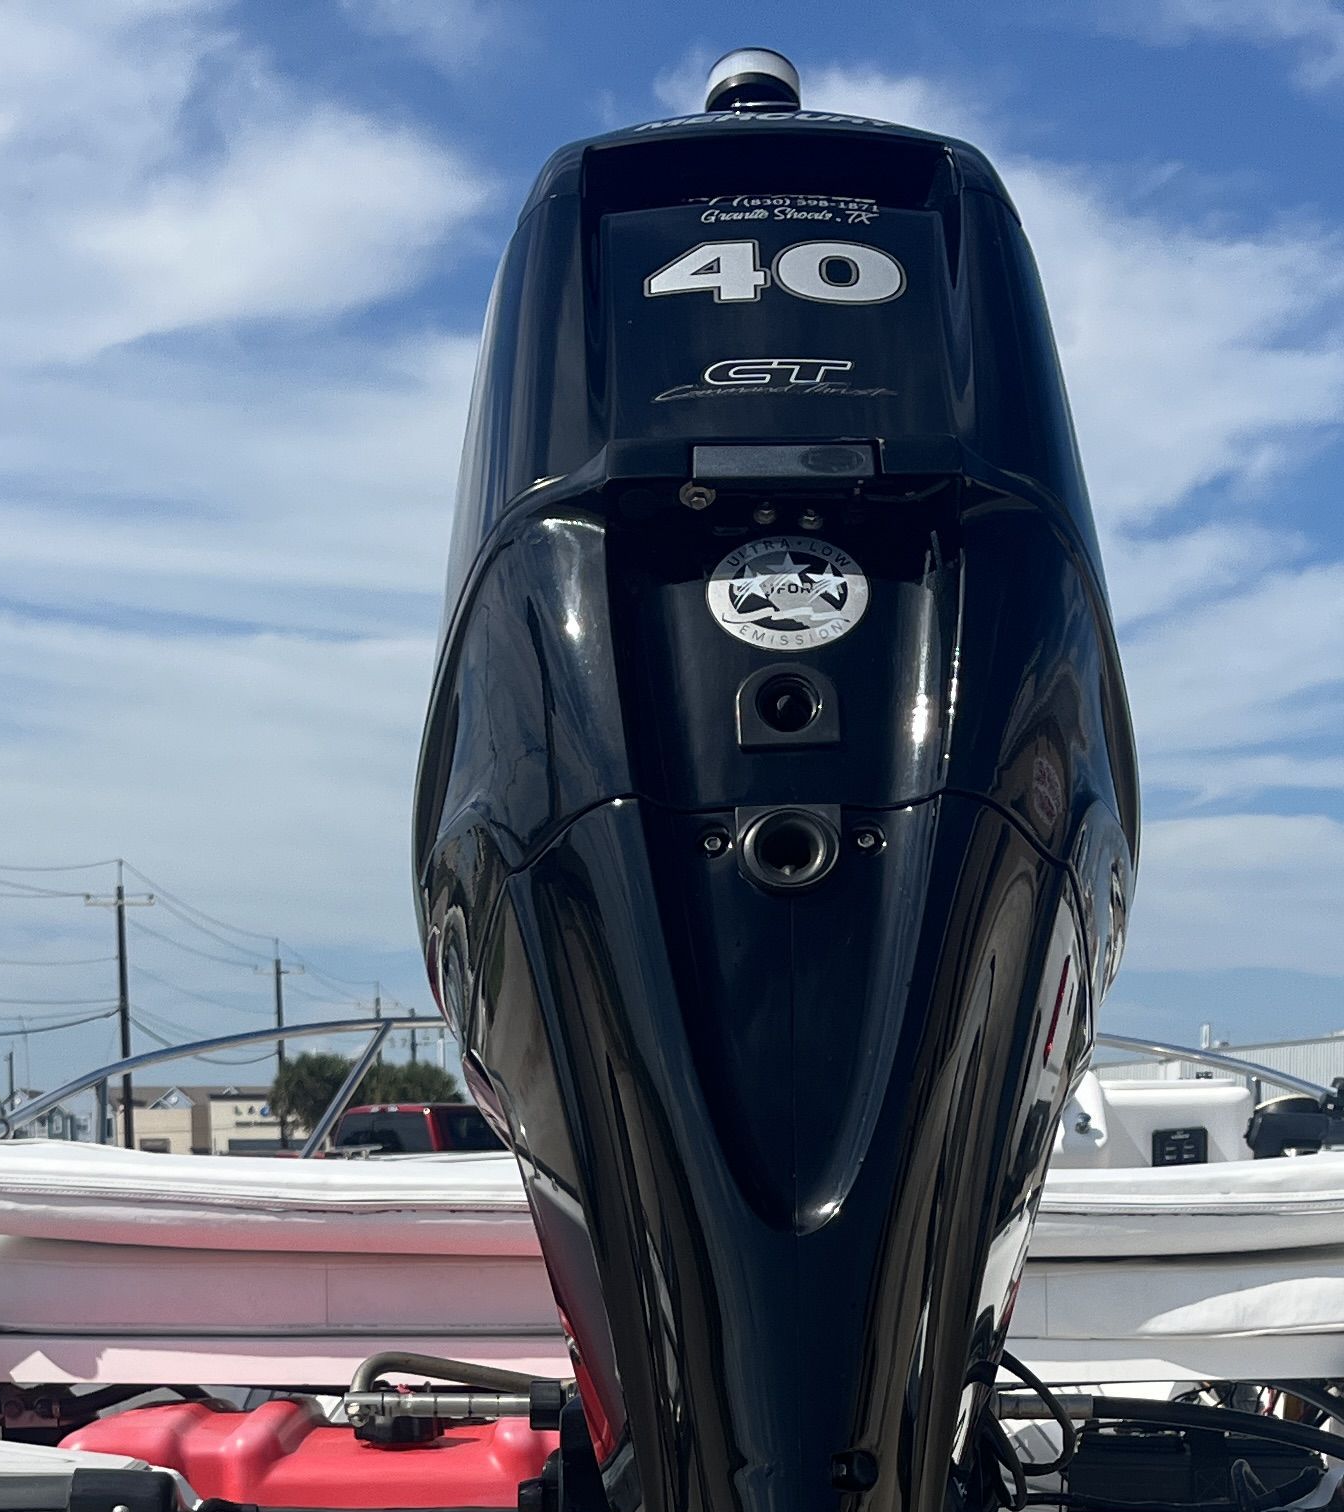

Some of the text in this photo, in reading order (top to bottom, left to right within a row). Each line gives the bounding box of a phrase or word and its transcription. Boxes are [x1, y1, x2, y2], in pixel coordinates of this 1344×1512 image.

[845, 211, 880, 225] TX
[643, 239, 908, 305] 40
[704, 358, 853, 385] GT
[727, 538, 852, 568] ULTRA LOW
[739, 620, 844, 646] EMISSION
